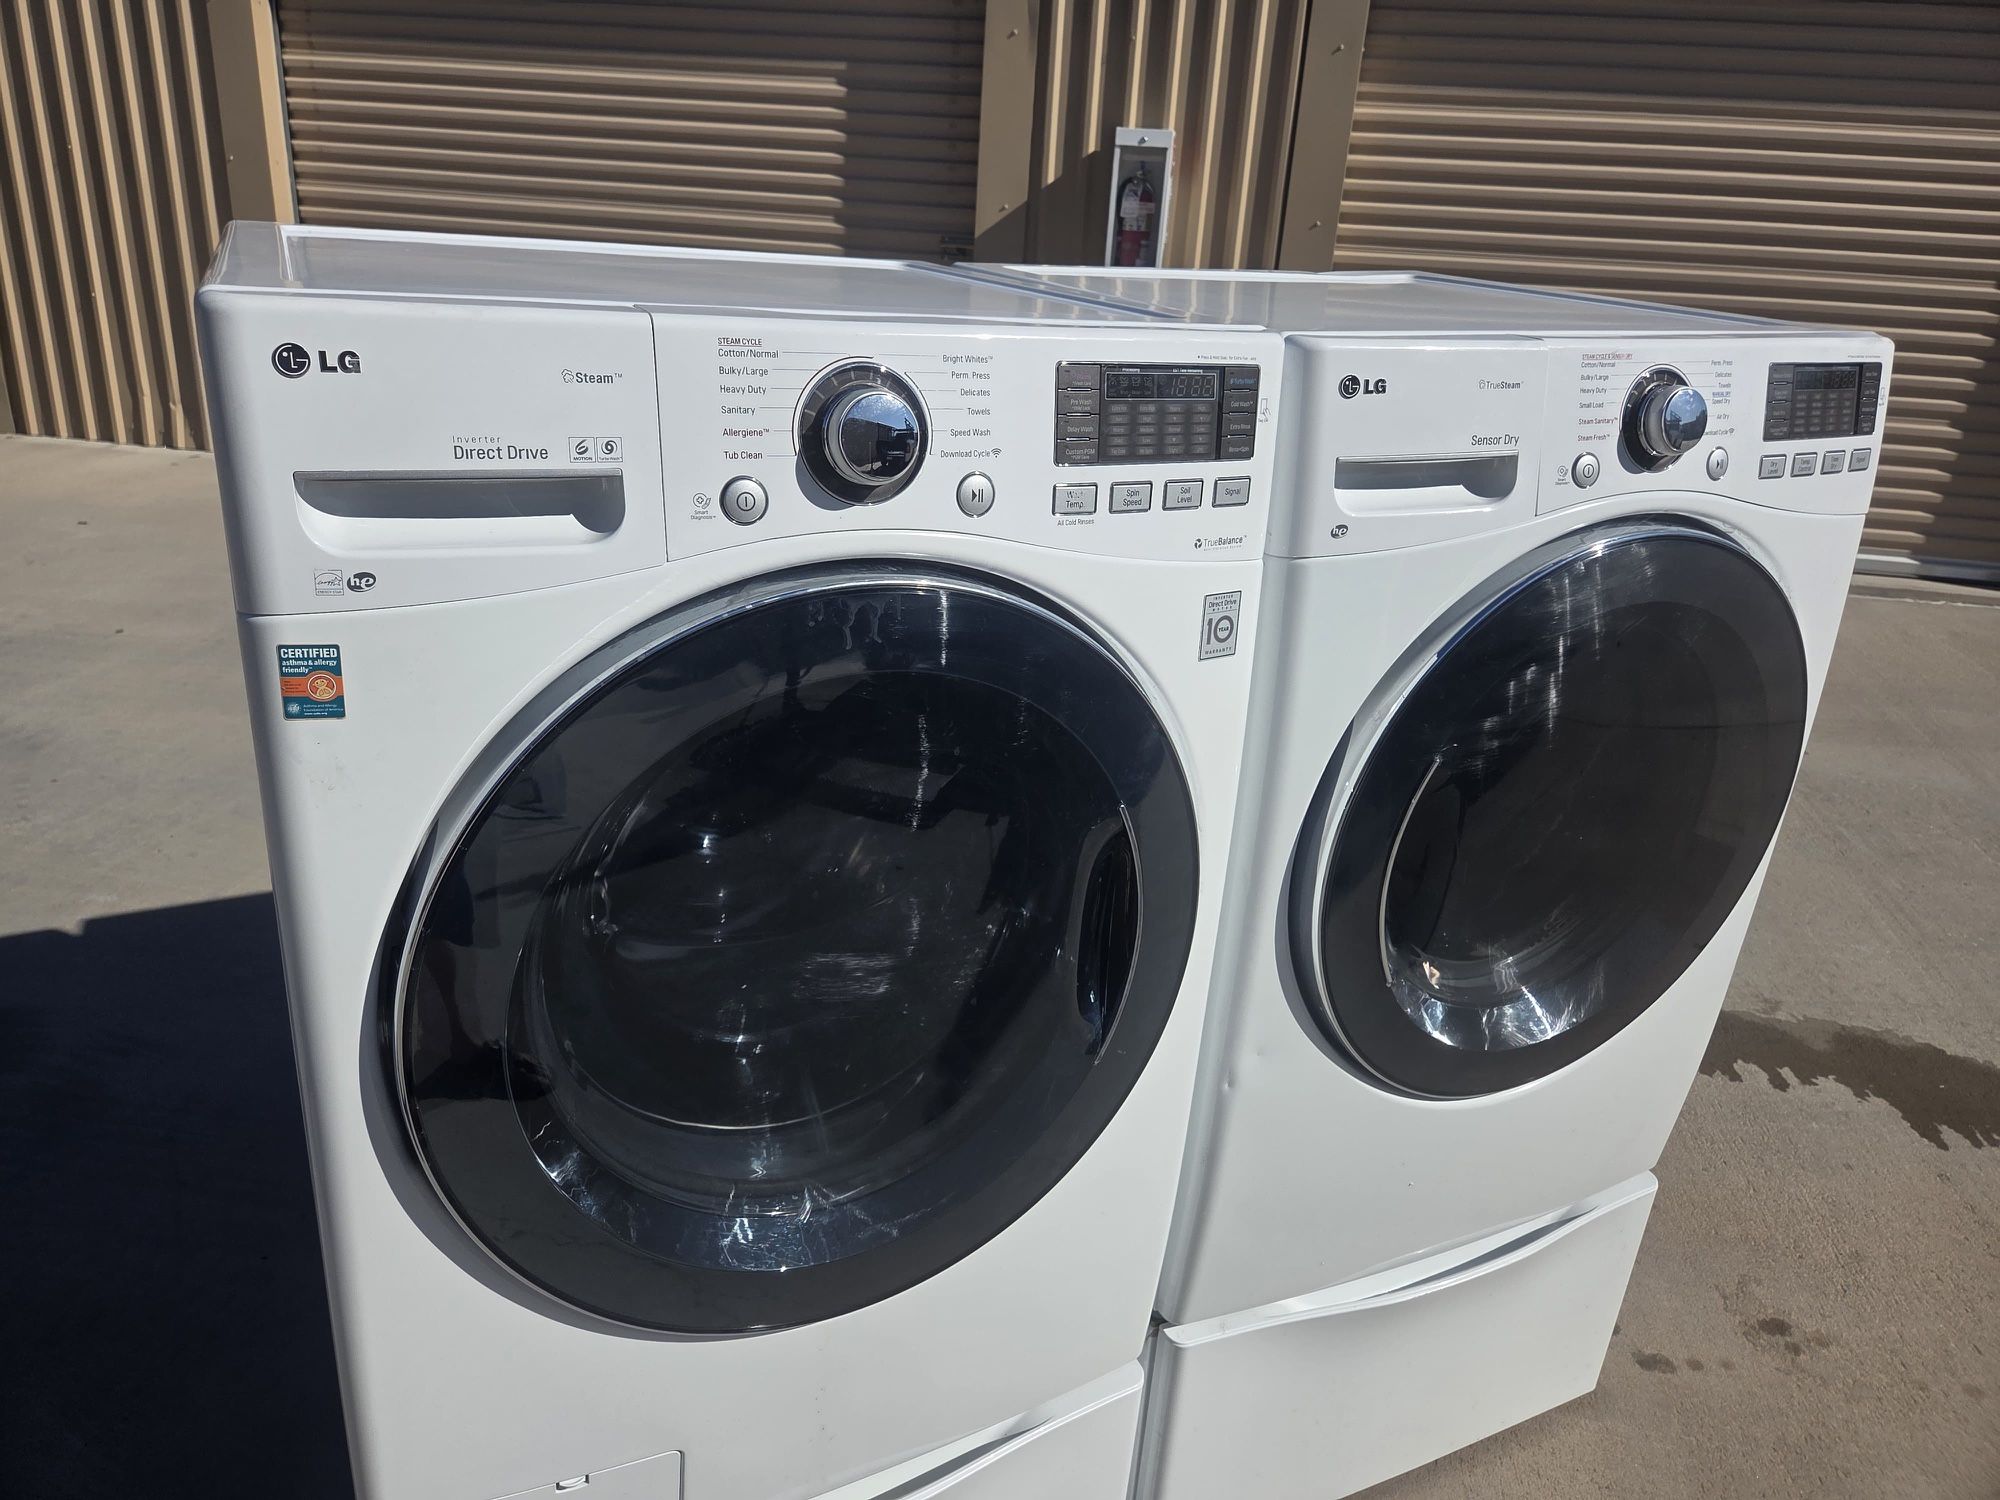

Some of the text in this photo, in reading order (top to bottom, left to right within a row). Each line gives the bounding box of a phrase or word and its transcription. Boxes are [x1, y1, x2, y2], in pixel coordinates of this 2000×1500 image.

[718, 337, 762, 346] STEAM CYCLE
[718, 348, 779, 359] Cotton/Normal
[318, 350, 361, 374] LG
[942, 354, 964, 364] Bright
[718, 366, 769, 377] Bulky/Large
[972, 371, 991, 380] Press
[720, 385, 767, 395] Heavy Duty
[1363, 378, 1387, 395] LG
[1580, 387, 1595, 395] Heavy
[960, 388, 991, 397] Delicates
[721, 406, 755, 415] Sanitary
[967, 407, 991, 416] Towels
[950, 428, 991, 438] Speed Wash
[452, 435, 501, 443] Inverter
[1471, 433, 1520, 447] Sensor Dry
[453, 445, 549, 460] Direct Drive
[724, 451, 763, 460] Tub Clean
[940, 449, 991, 459] Download Cycle
[1126, 489, 1140, 497] Spin
[1180, 486, 1191, 494] Soil
[1224, 487, 1242, 496] Signal
[1122, 498, 1142, 507] Speed
[1177, 495, 1193, 503] Level
[1077, 518, 1095, 526] Rinses
[1206, 615, 1234, 645] 10
[280, 648, 337, 658] CERTIFIED
[313, 658, 337, 667] allergy
